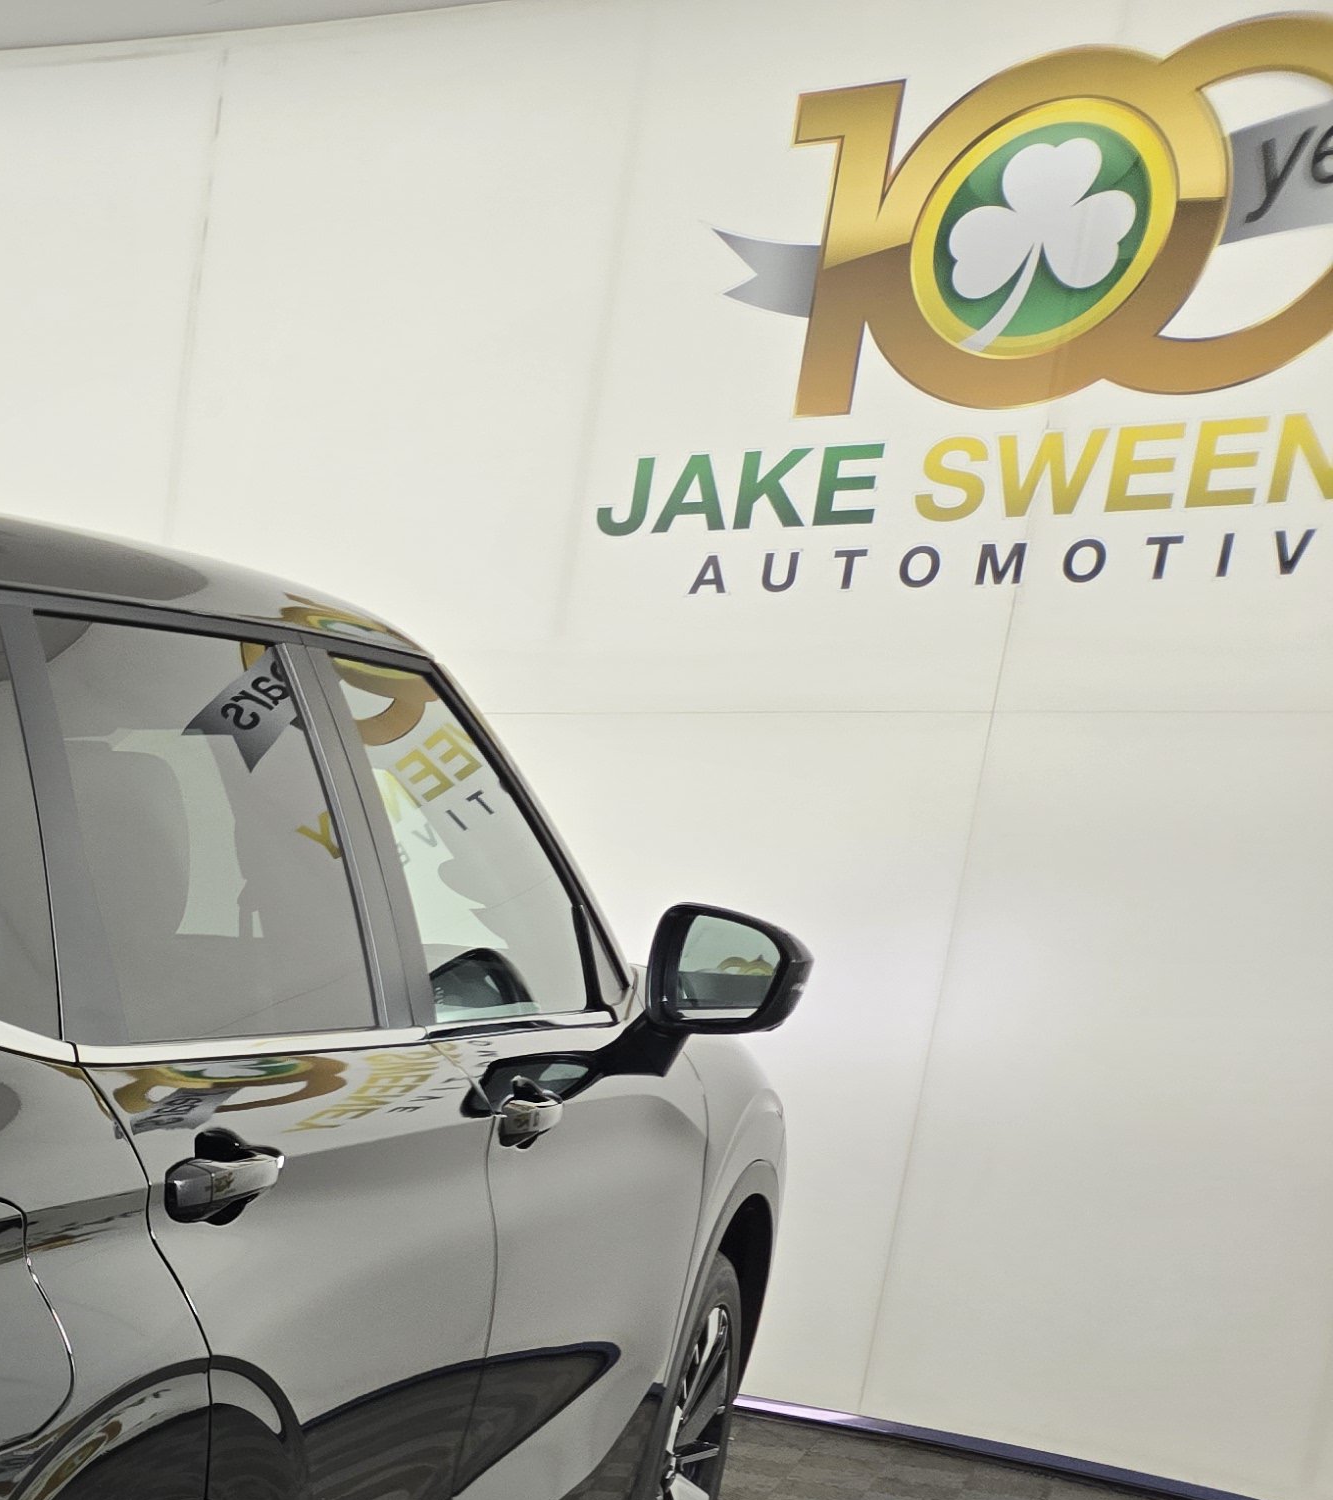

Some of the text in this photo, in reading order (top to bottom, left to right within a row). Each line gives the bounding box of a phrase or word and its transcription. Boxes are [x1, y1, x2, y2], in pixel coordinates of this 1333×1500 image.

[792, 9, 1333, 417] 100
[596, 412, 1333, 537] JAKE SWEEN
[687, 528, 1317, 596] AUTOMOTIV
